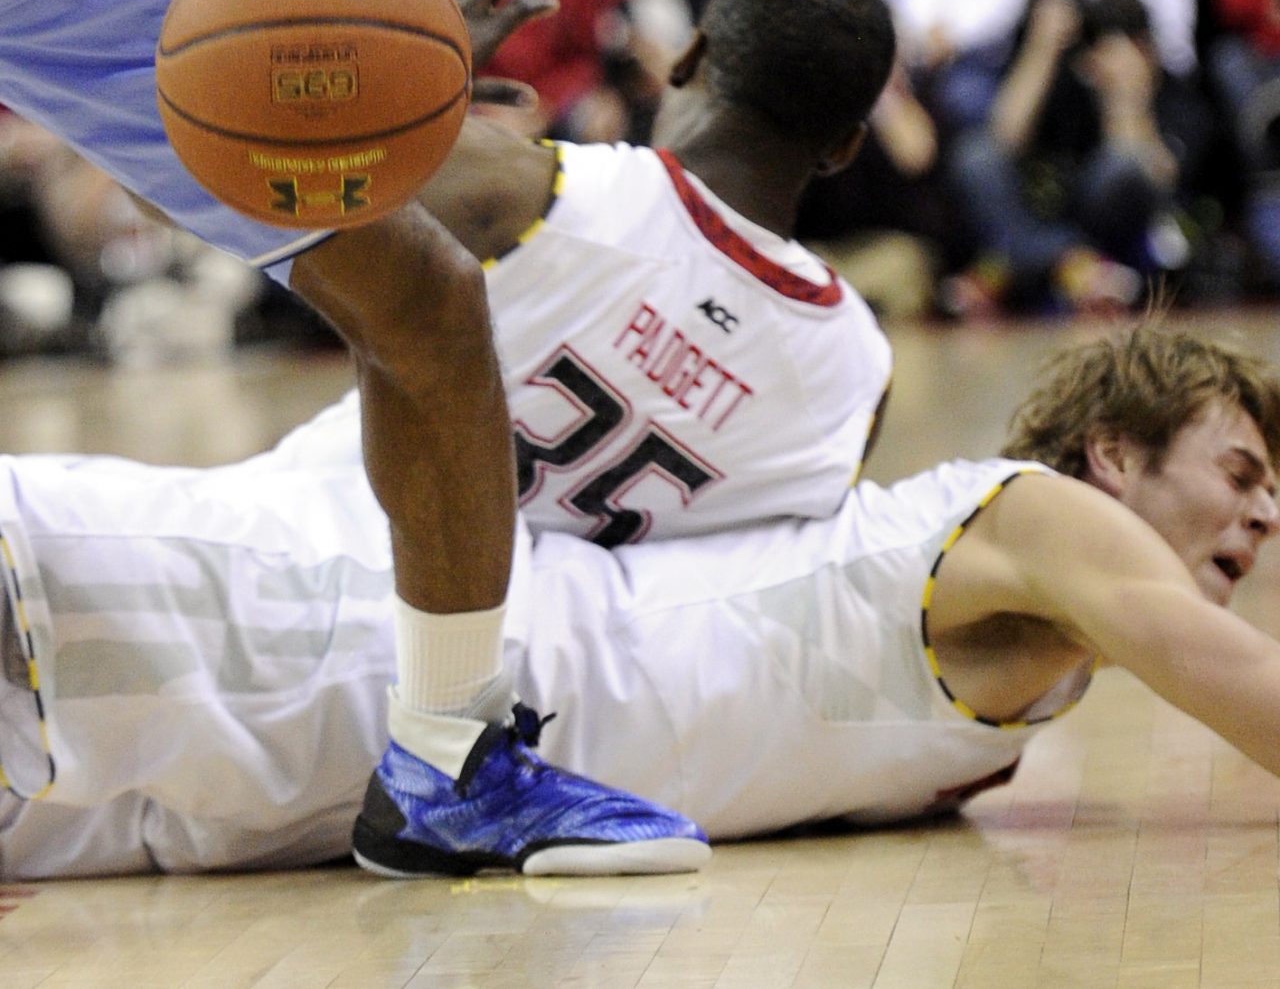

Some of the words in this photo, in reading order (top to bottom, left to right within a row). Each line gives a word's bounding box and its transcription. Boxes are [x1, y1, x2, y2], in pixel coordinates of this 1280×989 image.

[612, 301, 754, 433] PADGETT
[695, 296, 740, 335] ACC
[513, 342, 727, 550] 35
